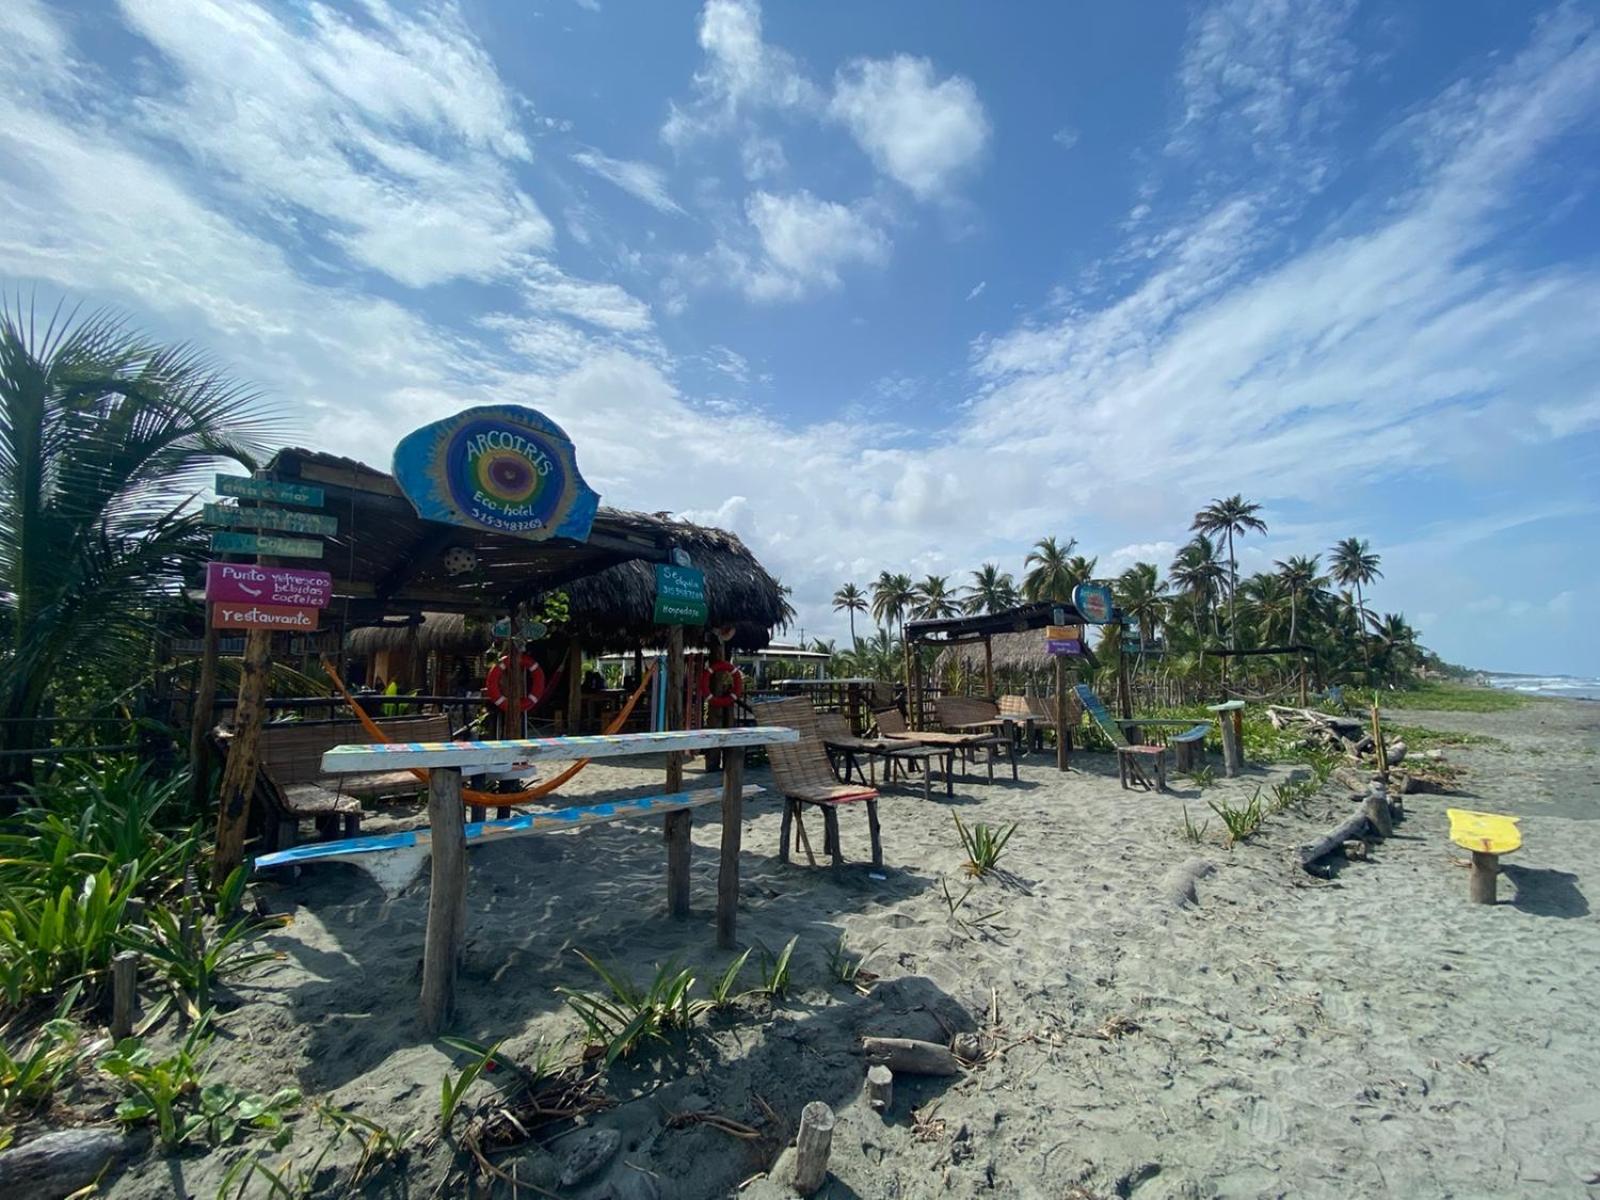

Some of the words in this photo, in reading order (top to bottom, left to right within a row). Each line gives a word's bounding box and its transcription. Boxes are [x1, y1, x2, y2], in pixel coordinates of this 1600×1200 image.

[466, 430, 553, 476] ARCOIRIS
[222, 567, 266, 581] Punto
[663, 567, 678, 579] Se
[274, 583, 323, 594] bebidas
[272, 593, 324, 606] cocteles
[222, 607, 312, 625] restaurante
